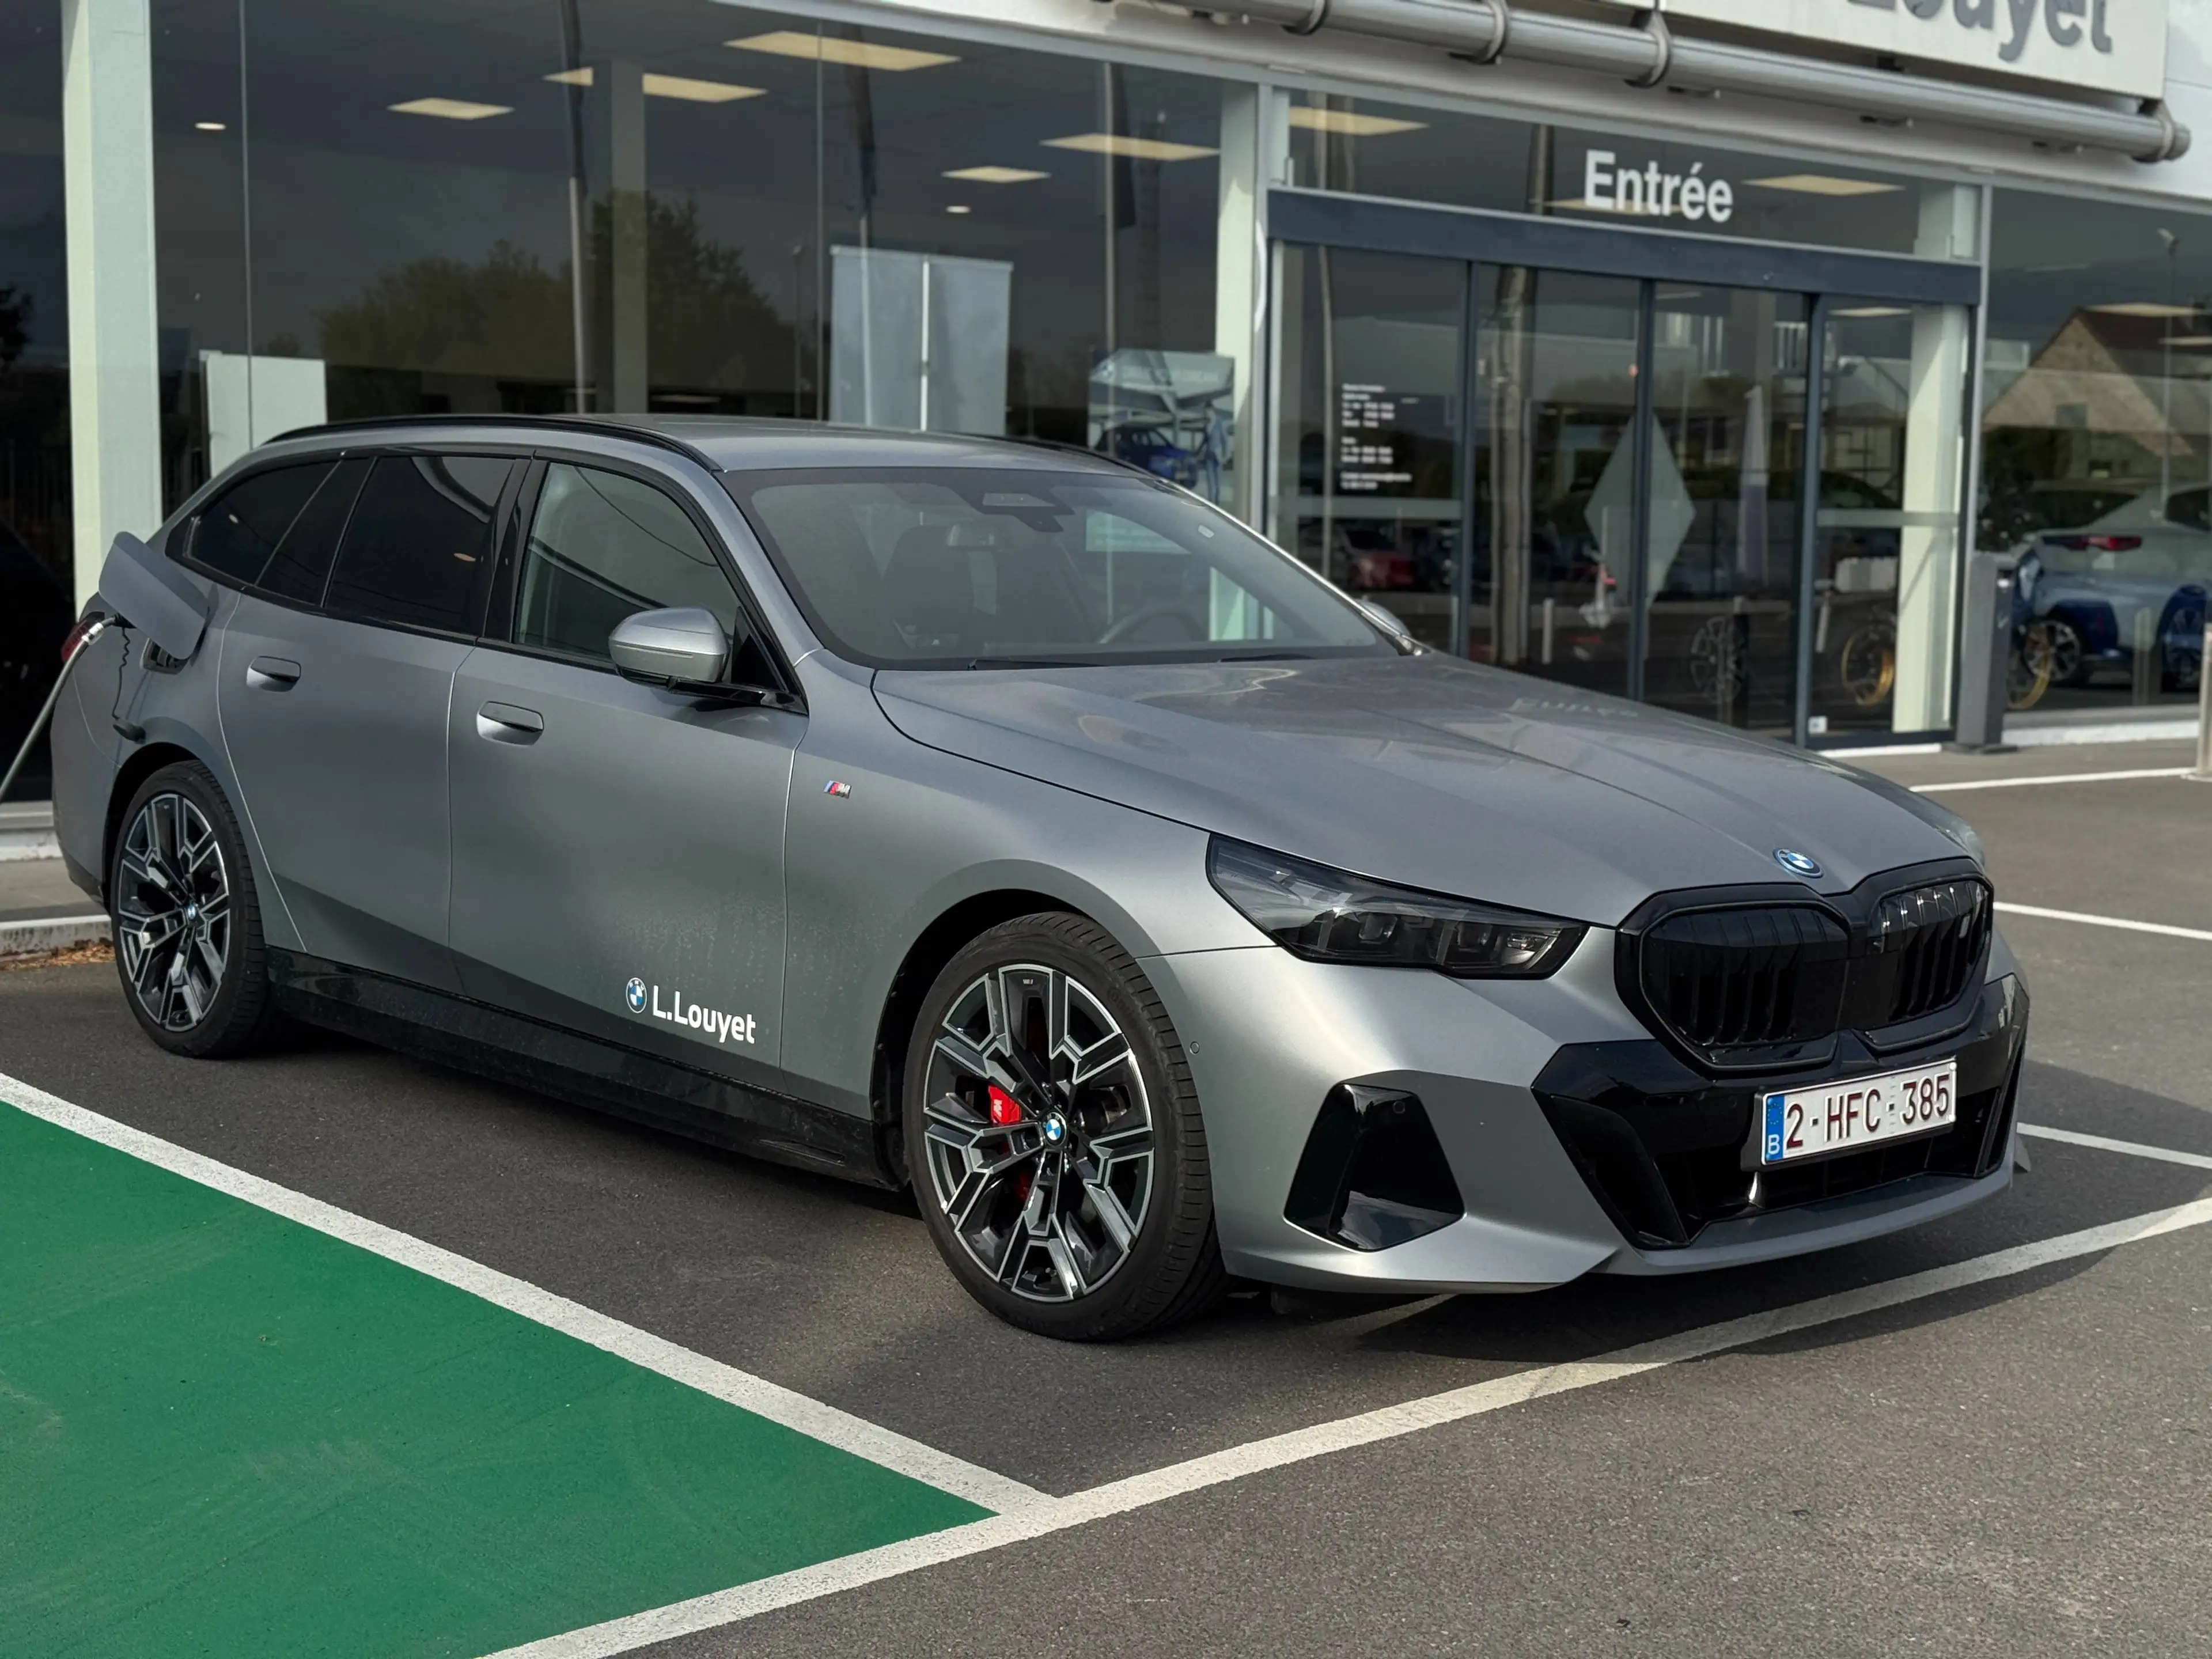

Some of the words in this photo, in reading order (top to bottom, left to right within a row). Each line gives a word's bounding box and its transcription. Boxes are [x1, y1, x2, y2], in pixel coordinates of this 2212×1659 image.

[1844, 0, 2112, 62] yet
[1585, 149, 1733, 223] Entrée
[653, 985, 756, 1044] L.Louyet
[1768, 1134, 1781, 1154] B
